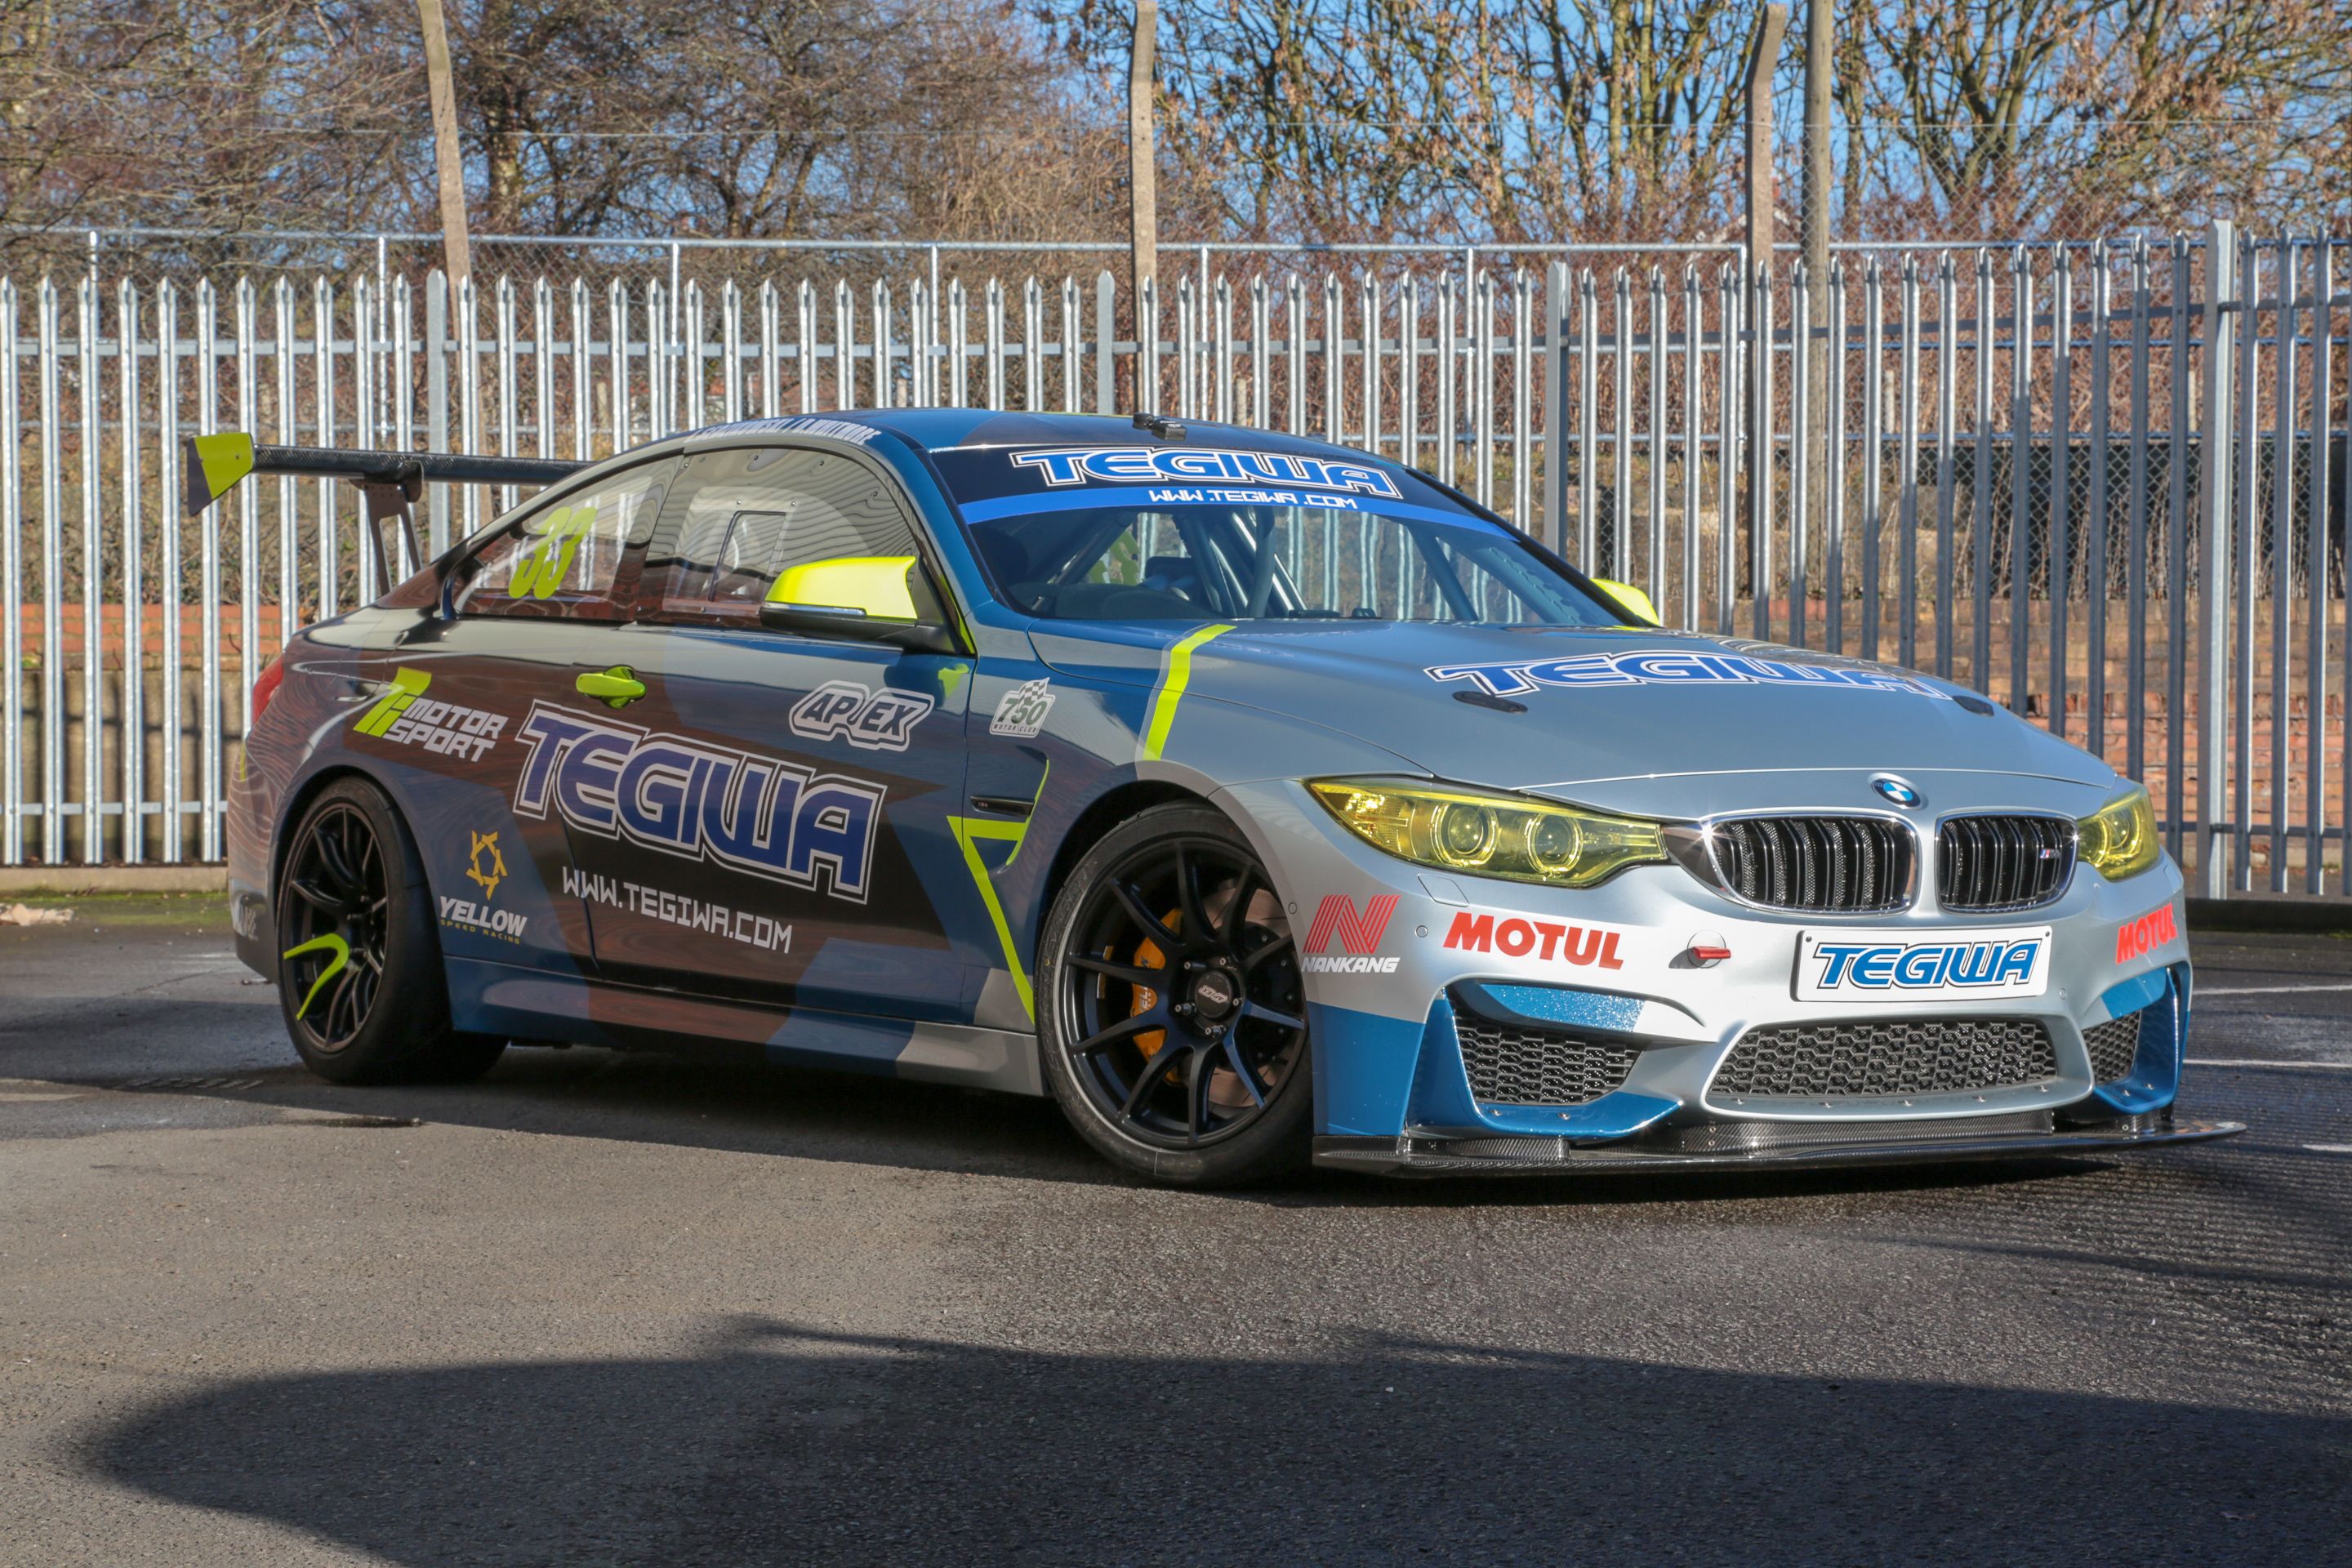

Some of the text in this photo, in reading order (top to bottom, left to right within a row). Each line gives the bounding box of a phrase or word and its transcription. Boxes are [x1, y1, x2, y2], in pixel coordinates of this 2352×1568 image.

[1012, 448, 1400, 497] TEGIWA
[508, 506, 598, 600] 33
[1429, 652, 1949, 699] TEGIWA
[401, 697, 509, 740] MOTOR
[798, 691, 920, 737] APEX
[993, 723, 1017, 732] MOTOR
[996, 697, 1048, 726] 750
[382, 718, 496, 763] SPORT
[517, 706, 884, 897] TEGIWA
[440, 895, 528, 938] YELLOW
[440, 919, 520, 946] SPEED RACING
[562, 866, 793, 954] WWW.TEGIWA.COM
[2116, 902, 2177, 964] MOTUL
[1442, 911, 1624, 970] MOTUL
[1301, 956, 1401, 973] NANKANG
[1815, 939, 2042, 989] TEGIWA
